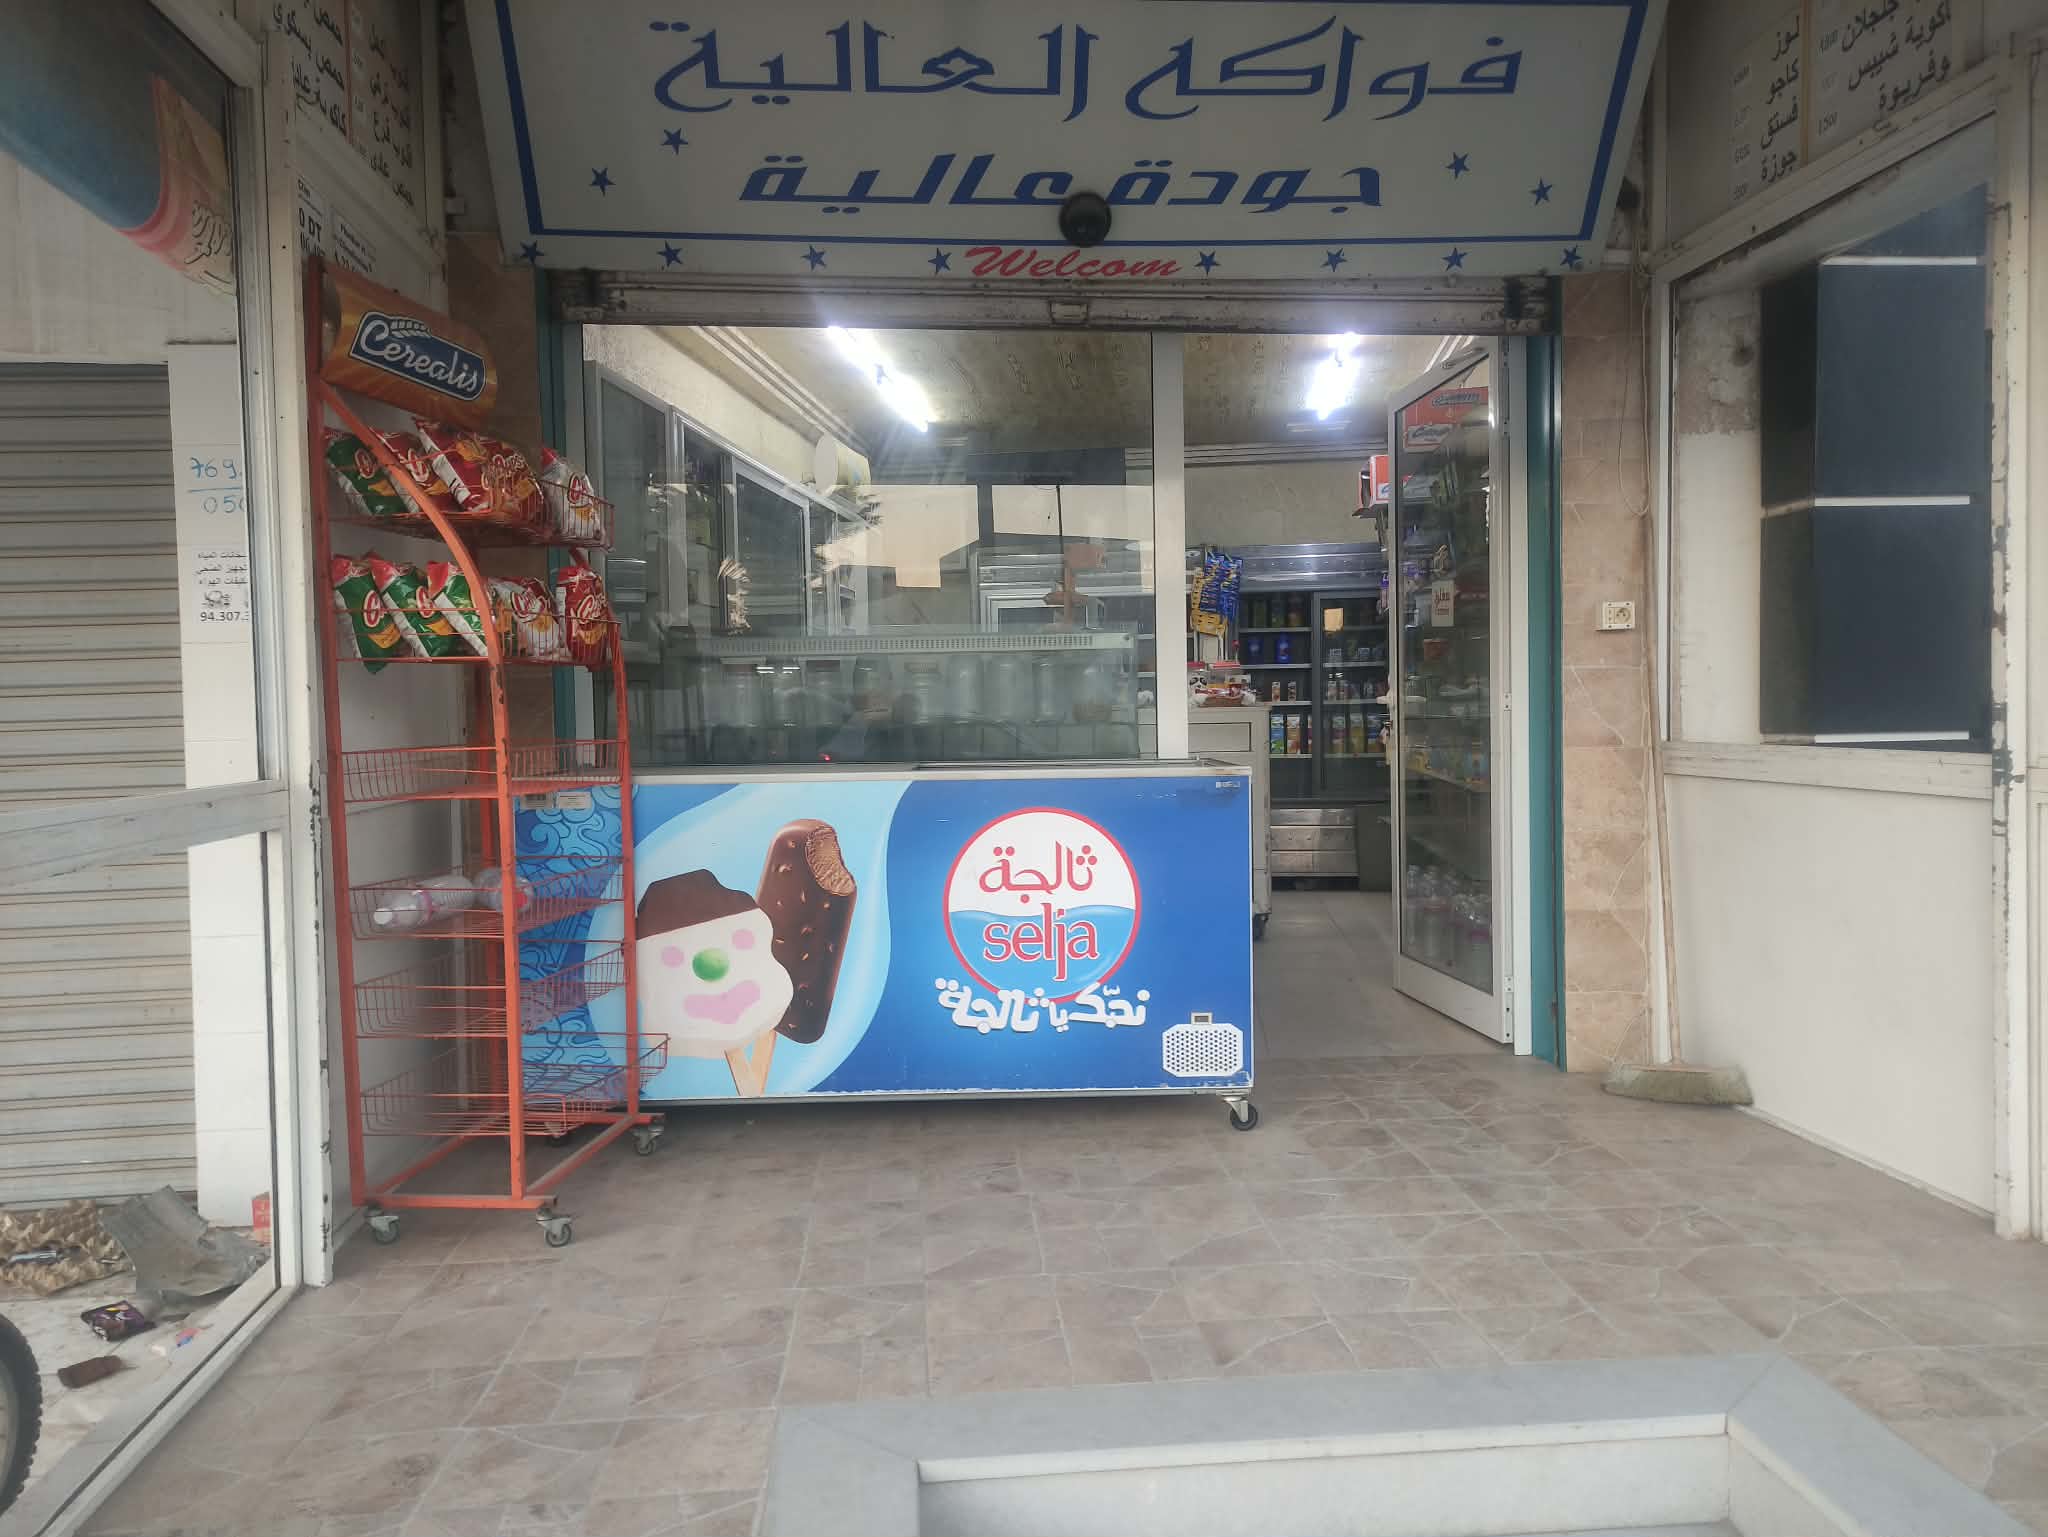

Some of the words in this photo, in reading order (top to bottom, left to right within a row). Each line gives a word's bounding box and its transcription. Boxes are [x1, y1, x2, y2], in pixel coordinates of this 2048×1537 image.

[1106, 159, 1383, 215] جودة
[964, 246, 1183, 278] Welcom
[359, 319, 479, 393] Cerealis
[979, 840, 1098, 904] ثالجة
[982, 902, 1100, 983] selja
[935, 977, 1050, 1035] ثالجة
